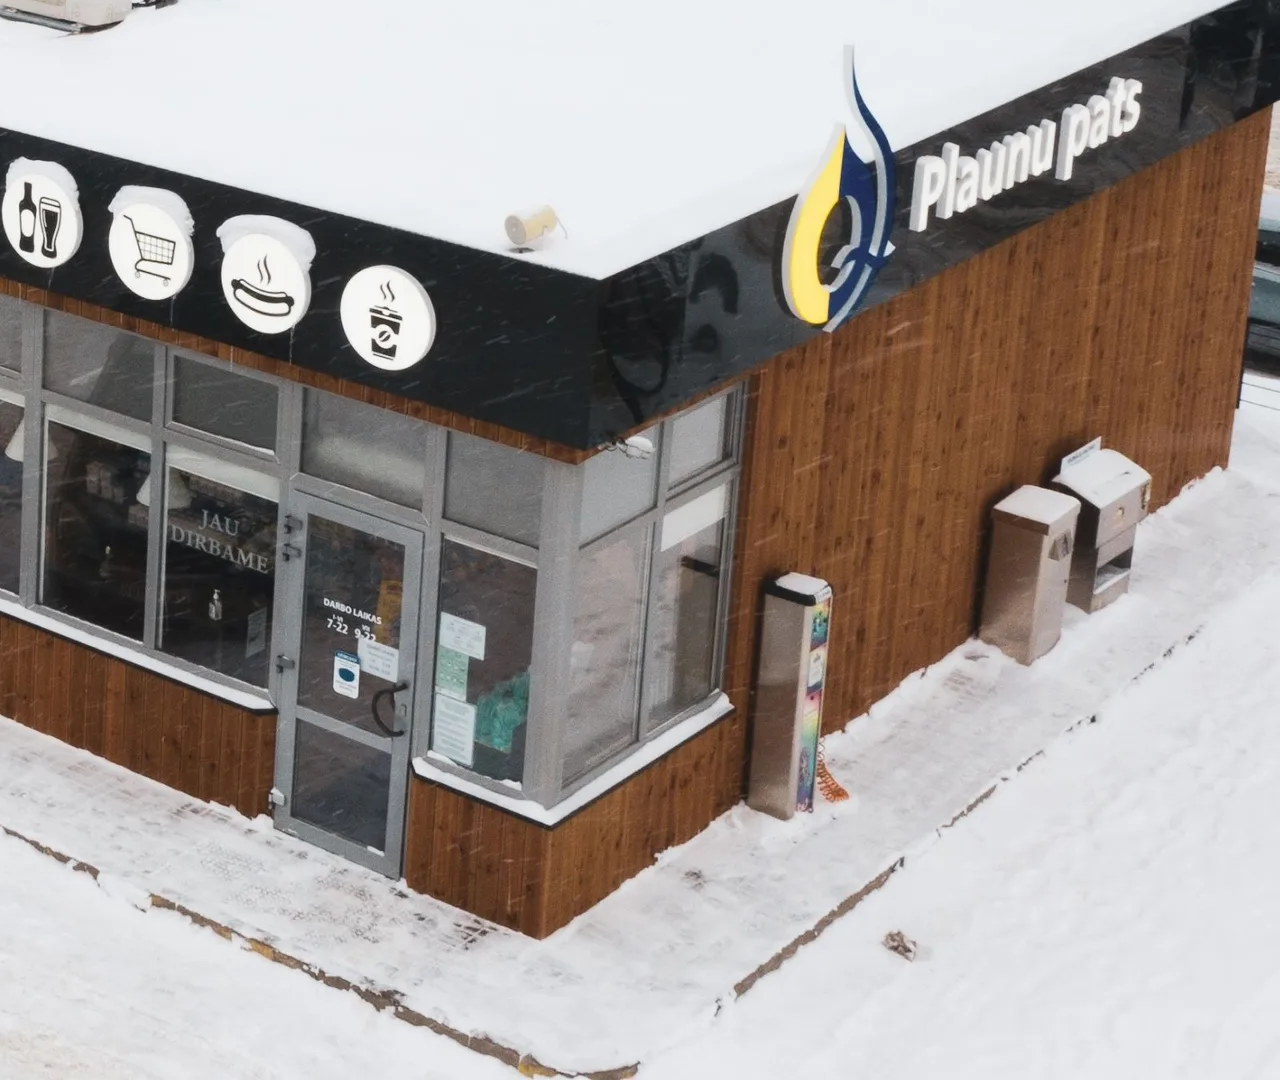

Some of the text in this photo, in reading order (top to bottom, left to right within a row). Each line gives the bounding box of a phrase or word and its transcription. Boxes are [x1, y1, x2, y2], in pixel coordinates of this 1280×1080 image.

[909, 76, 1142, 232] Plaunu pats
[198, 509, 240, 536] JAU
[171, 525, 269, 573] DIRBAME
[323, 597, 382, 625] DARBO LAIKAS
[326, 618, 349, 635] 7-22
